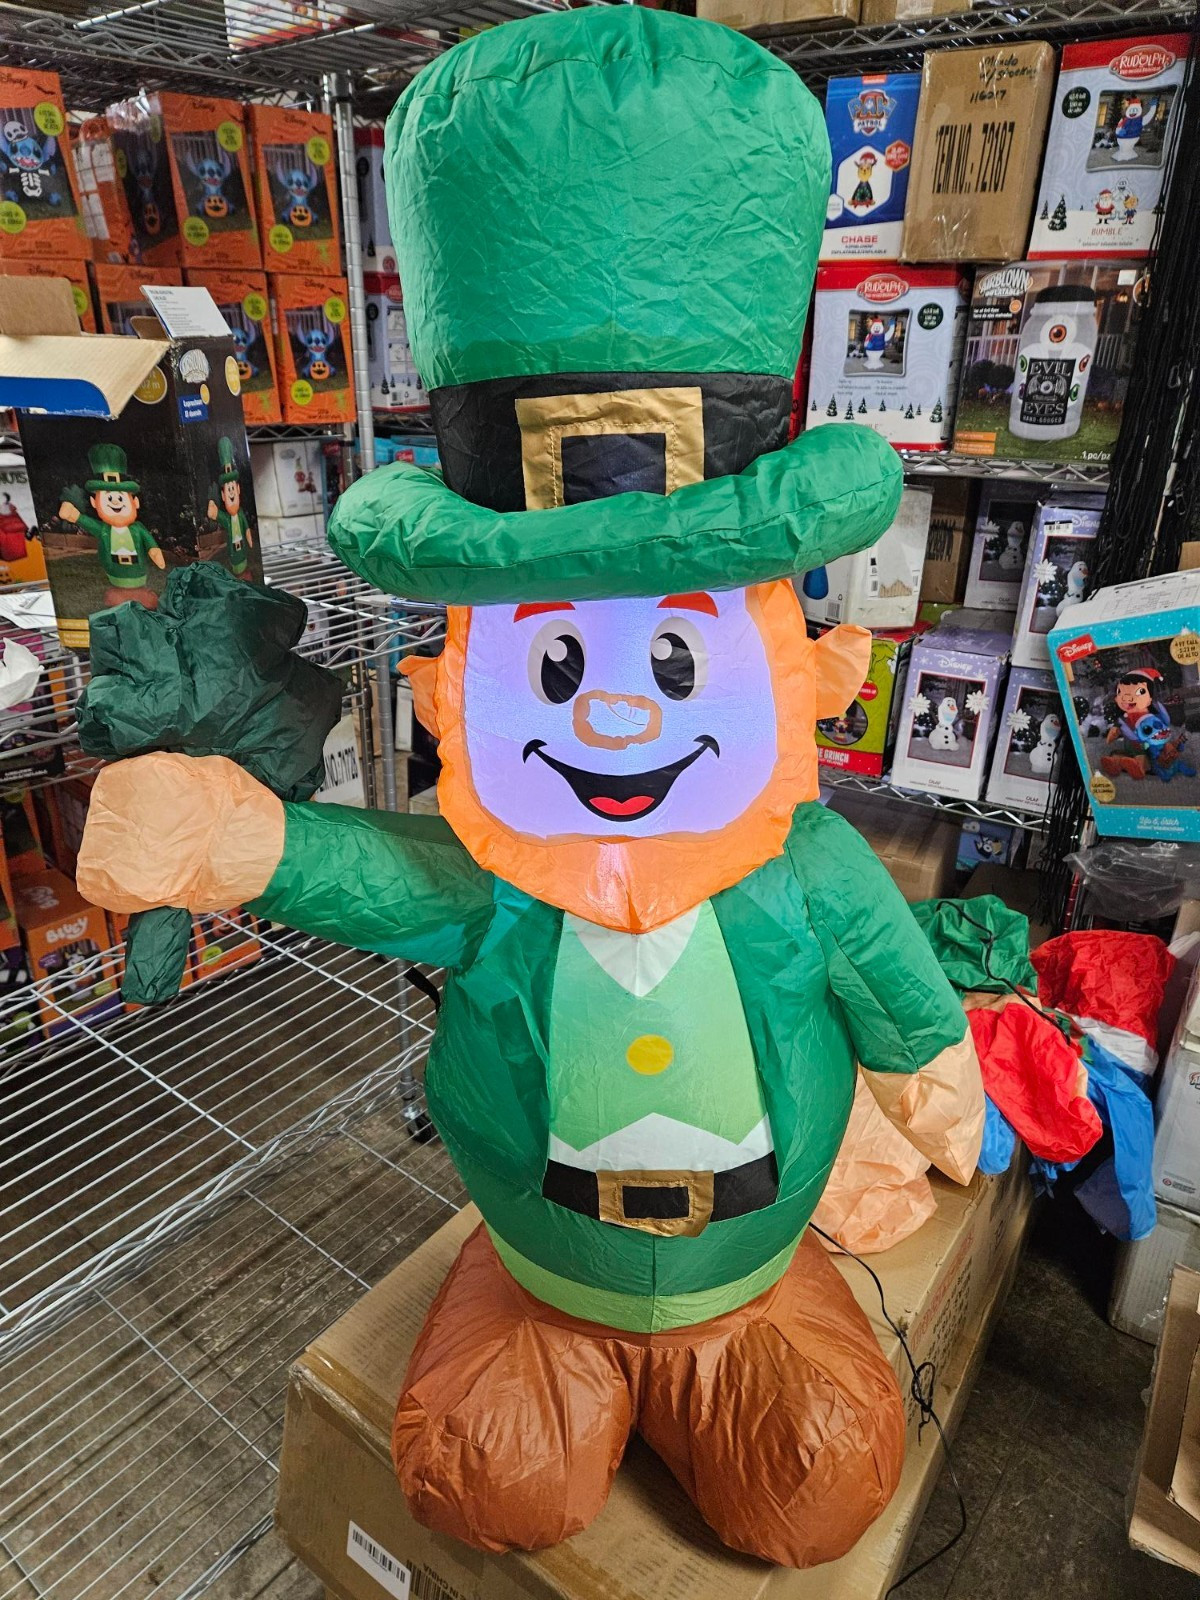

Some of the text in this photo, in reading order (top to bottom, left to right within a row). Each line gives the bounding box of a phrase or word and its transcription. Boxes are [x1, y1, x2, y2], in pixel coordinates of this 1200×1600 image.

[1119, 52, 1166, 69] RUDOLPH
[857, 119, 883, 128] PATROL
[975, 120, 1016, 194] 72187
[841, 235, 878, 244] CHASE
[1091, 227, 1122, 236] BUMBLE
[864, 279, 900, 292] RUDOLPH
[980, 268, 1030, 294] AIRBLOWN
[1030, 360, 1072, 377] EVIL
[1023, 402, 1065, 415] EYES
[1059, 641, 1093, 657] Disney
[934, 654, 973, 674] Disney
[824, 748, 850, 764] GRINCH
[423, 1562, 459, 1597] IN CHINA
